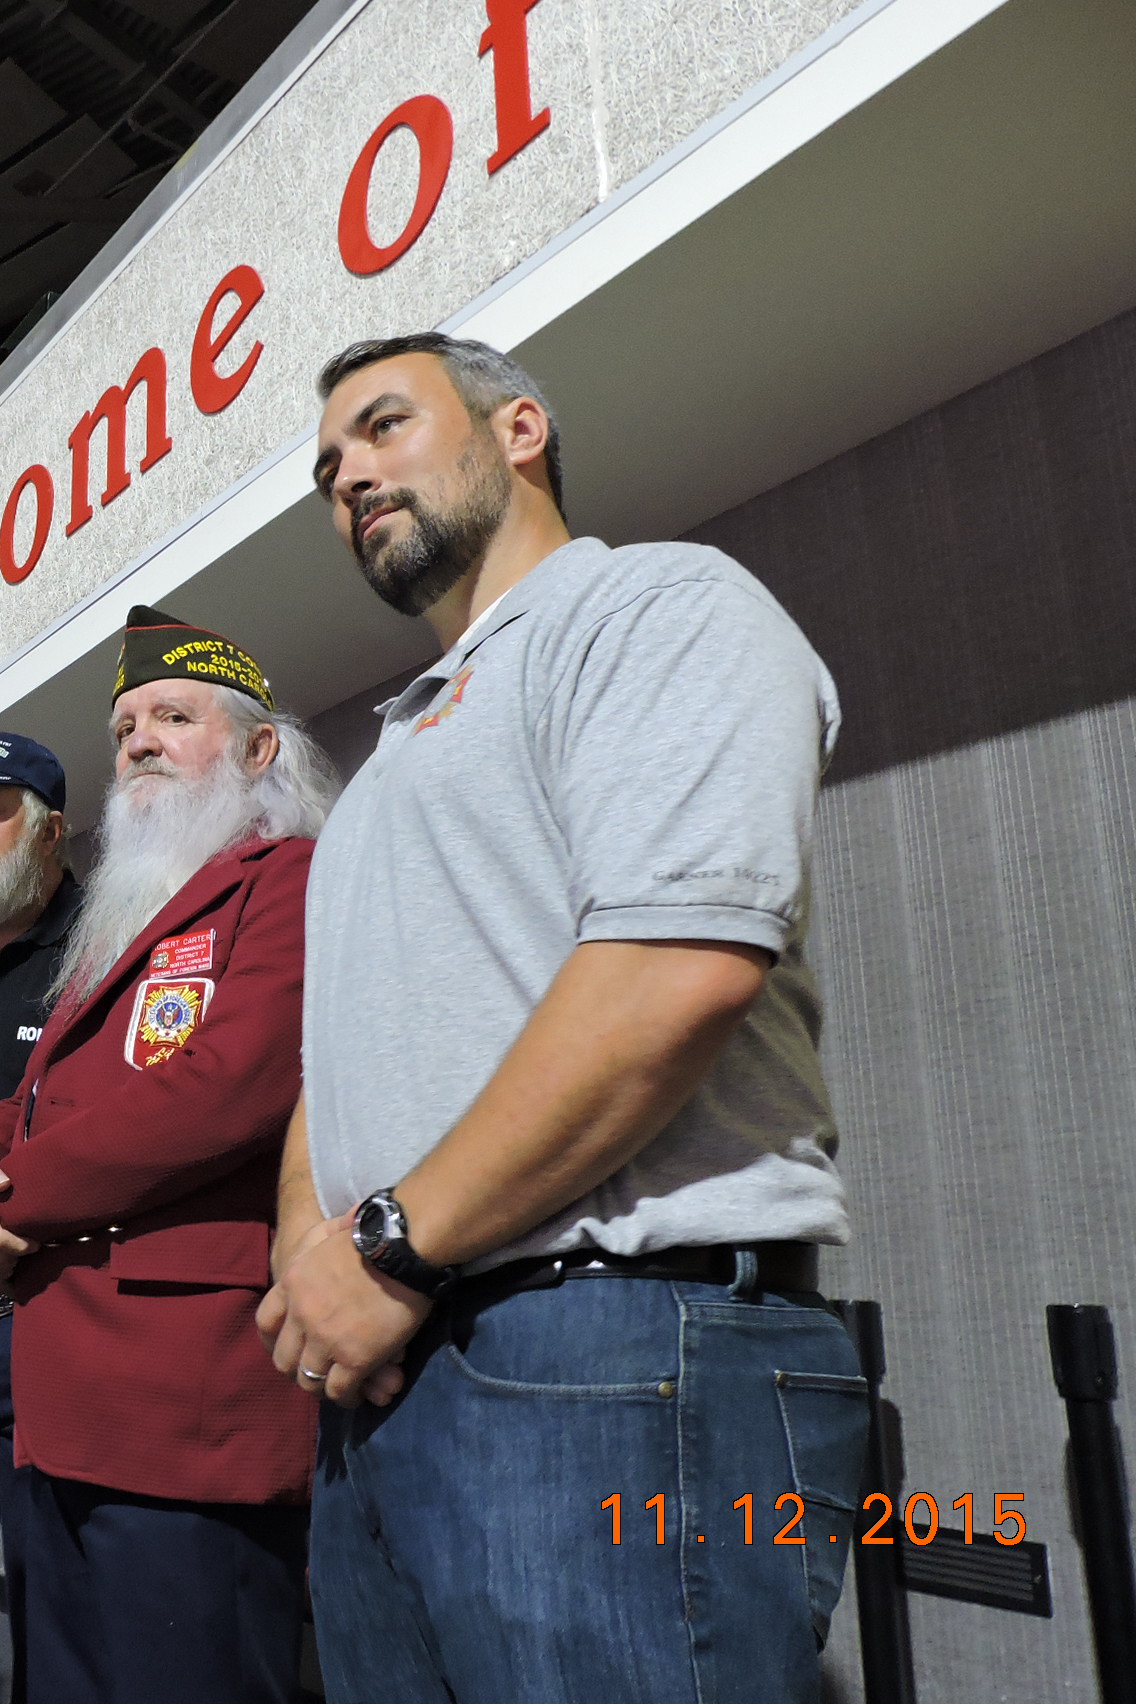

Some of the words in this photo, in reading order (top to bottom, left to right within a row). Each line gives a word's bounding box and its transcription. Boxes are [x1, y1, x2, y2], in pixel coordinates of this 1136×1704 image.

[162, 640, 224, 666] DISTRICT
[226, 644, 235, 656] 7
[186, 661, 237, 682] NORTH
[155, 940, 180, 951] OBERT
[183, 934, 211, 946] CARTER
[174, 944, 207, 954] COMMANDER
[175, 951, 199, 961] DISTRICT
